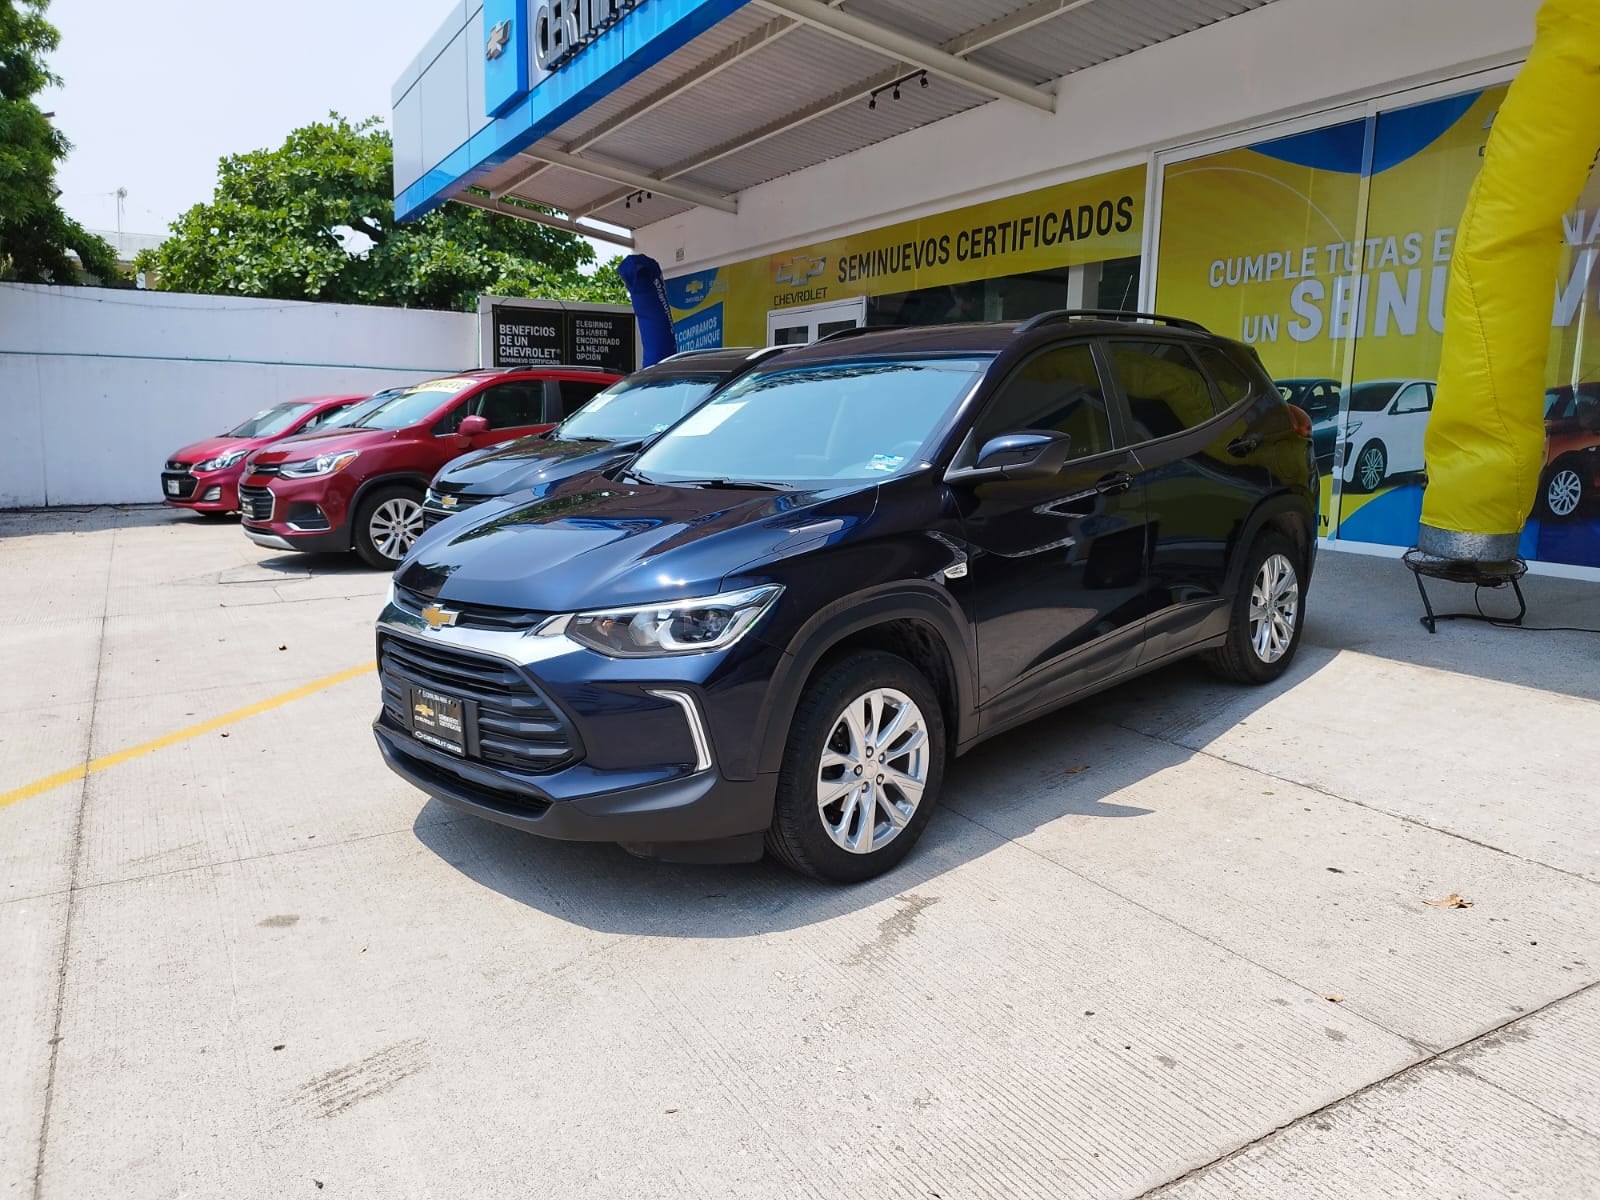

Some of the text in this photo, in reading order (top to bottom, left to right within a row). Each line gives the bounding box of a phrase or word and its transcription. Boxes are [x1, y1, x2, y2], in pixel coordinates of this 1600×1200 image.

[838, 195, 1134, 283] SEMINUEVOS CERTIFICADOS
[1209, 246, 1319, 288] CUMPLE
[773, 286, 828, 306] CHEVROLET
[499, 324, 556, 337] BENEFICIOS
[575, 328, 608, 337] ES HABER
[678, 316, 718, 342] COMPRAMOS
[696, 328, 721, 348] AUNQUE
[1243, 314, 1279, 344] UN
[499, 335, 529, 347] DE UN
[575, 336, 621, 346] ENCONTRADO
[575, 344, 609, 353] LA MEJOR
